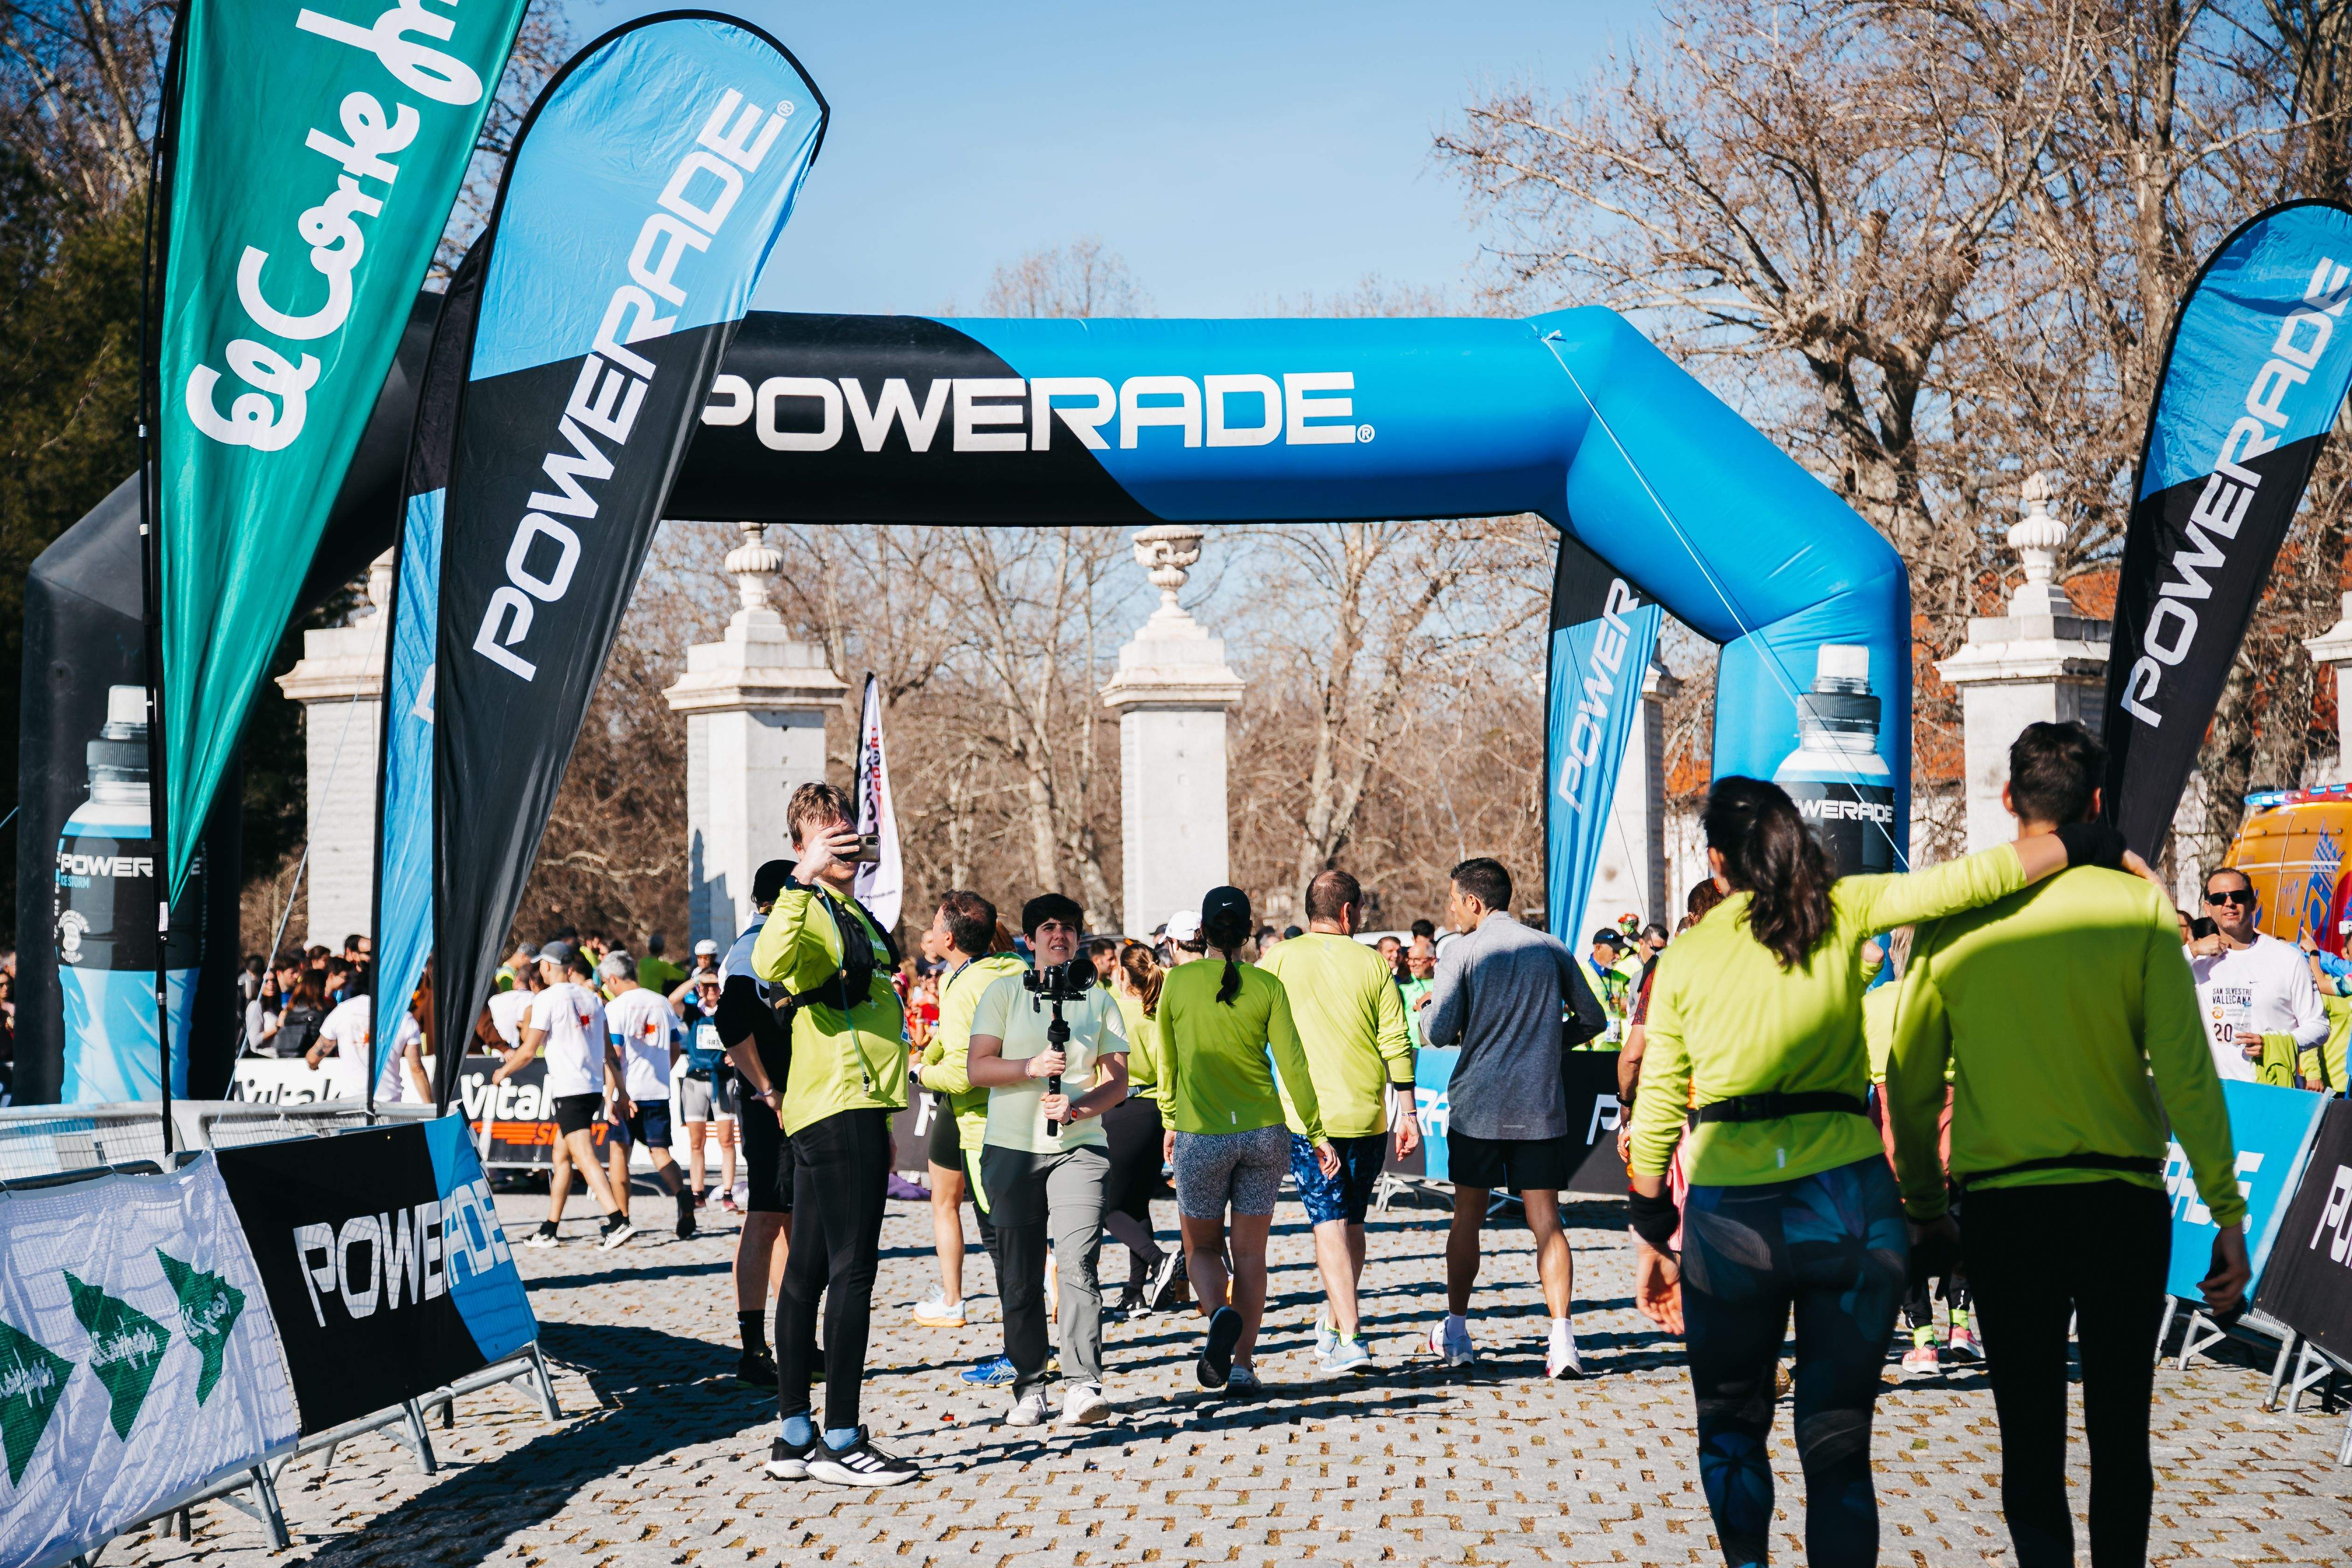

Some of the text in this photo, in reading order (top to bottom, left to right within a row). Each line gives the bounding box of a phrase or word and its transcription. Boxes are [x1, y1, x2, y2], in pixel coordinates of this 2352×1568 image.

[237, 91, 420, 340] Corte
[186, 339, 321, 451] El
[1558, 577, 1639, 814] POWER
[1792, 799, 1893, 823] WERADE
[2212, 995, 2251, 1004] VALLECANA
